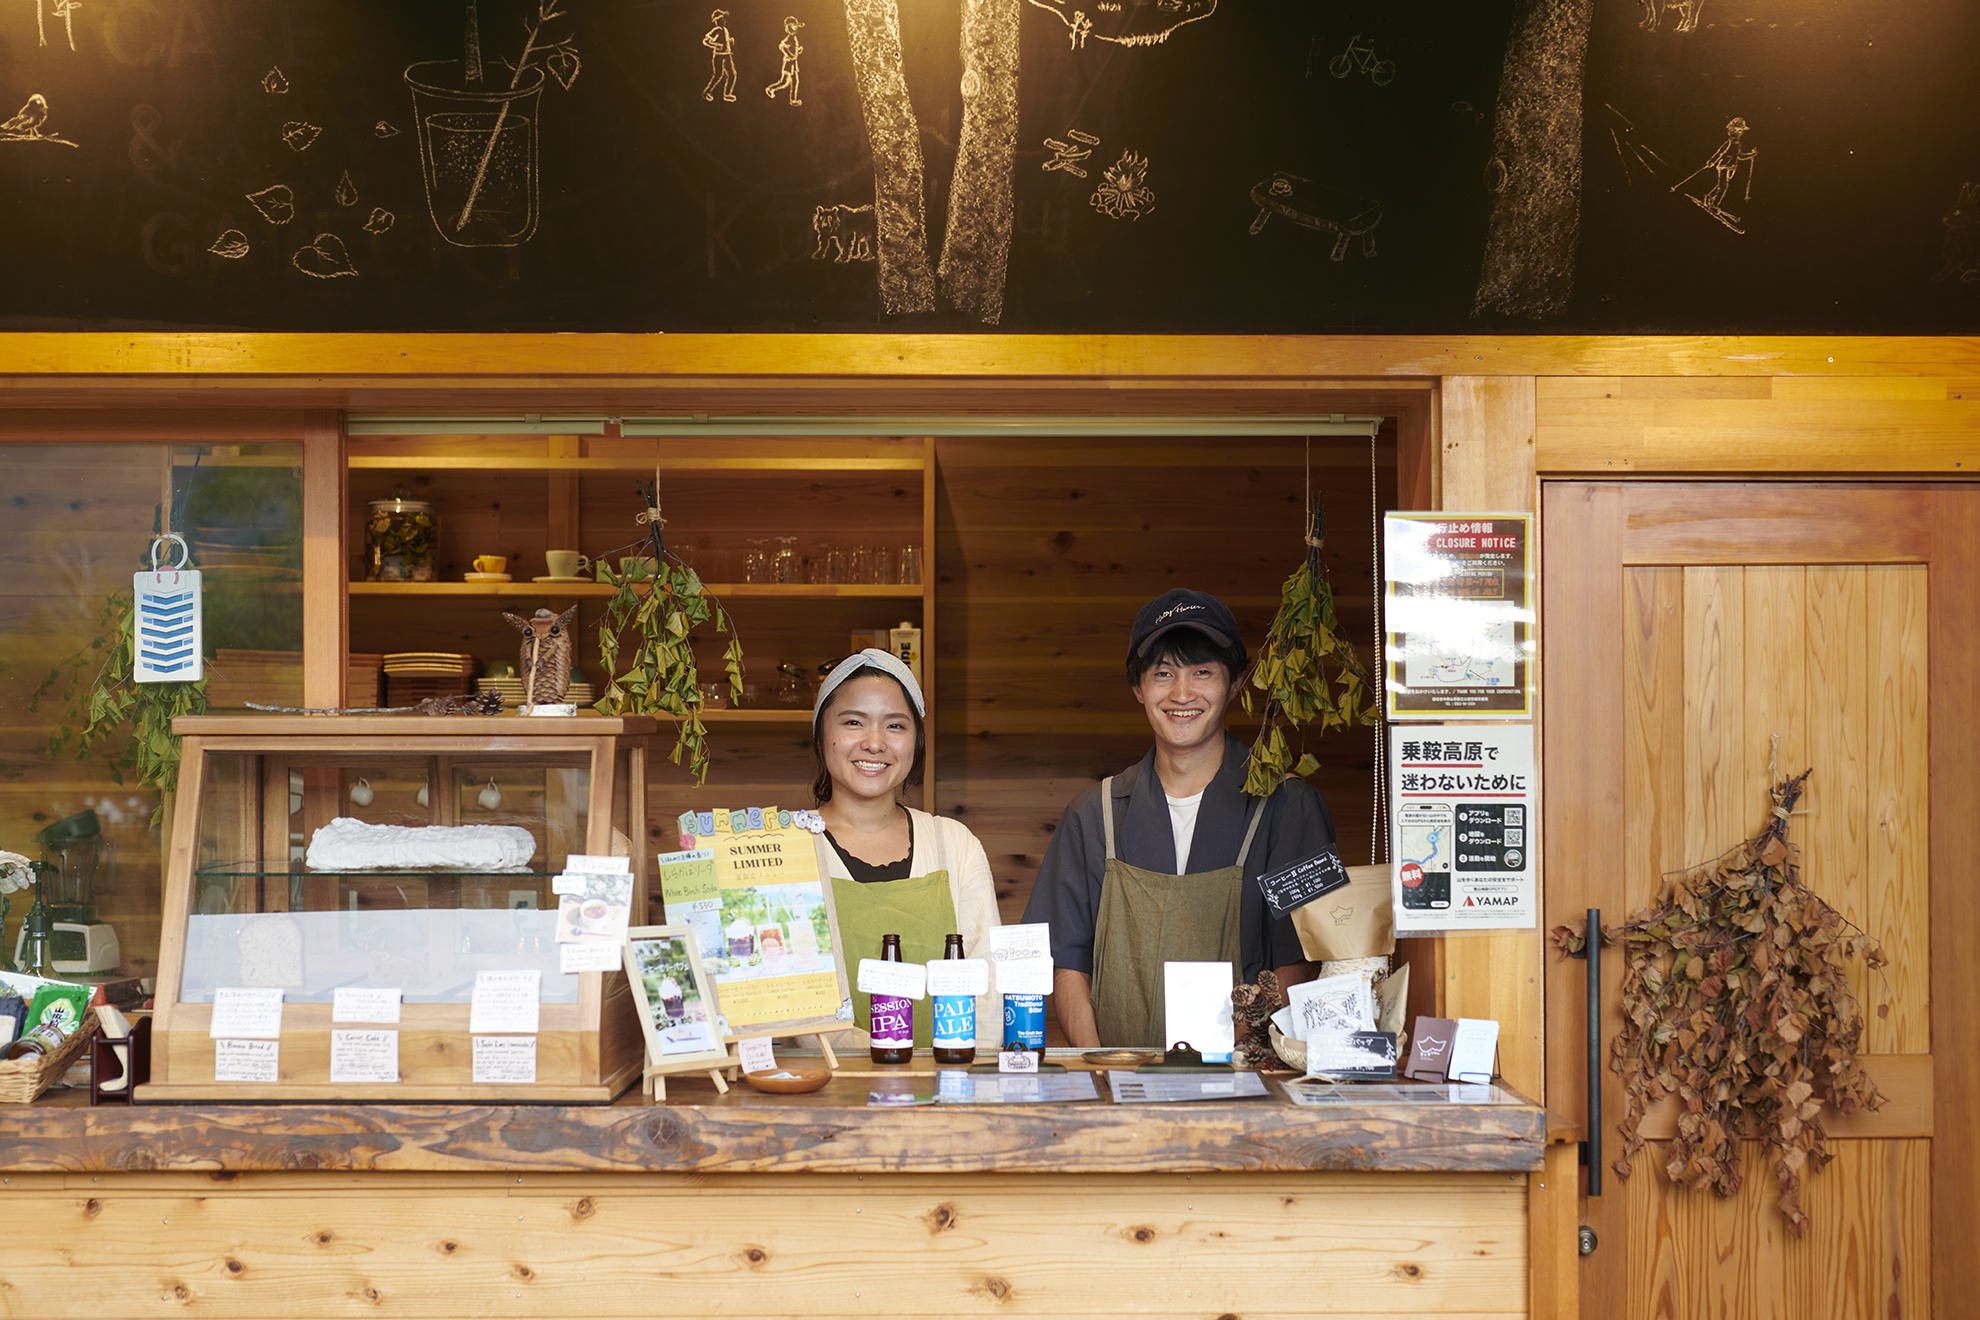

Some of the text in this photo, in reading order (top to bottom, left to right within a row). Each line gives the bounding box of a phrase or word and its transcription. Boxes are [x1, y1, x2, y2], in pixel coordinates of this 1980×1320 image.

[1436, 537, 1516, 548] CLOSURE NOTICE
[1401, 741, 1500, 761] 乗鞍高原で
[1401, 774, 1526, 791] 迷わないために
[729, 843, 782, 856] SUMMER
[733, 858, 783, 870] LIMITED
[1402, 870, 1422, 882] 無料
[702, 883, 717, 894] Soda
[692, 900, 714, 912] ¥550
[1476, 897, 1518, 906] YAMAP
[1009, 948, 1030, 958] 900
[871, 1013, 909, 1033] IPA
[935, 1016, 973, 1035] ALE
